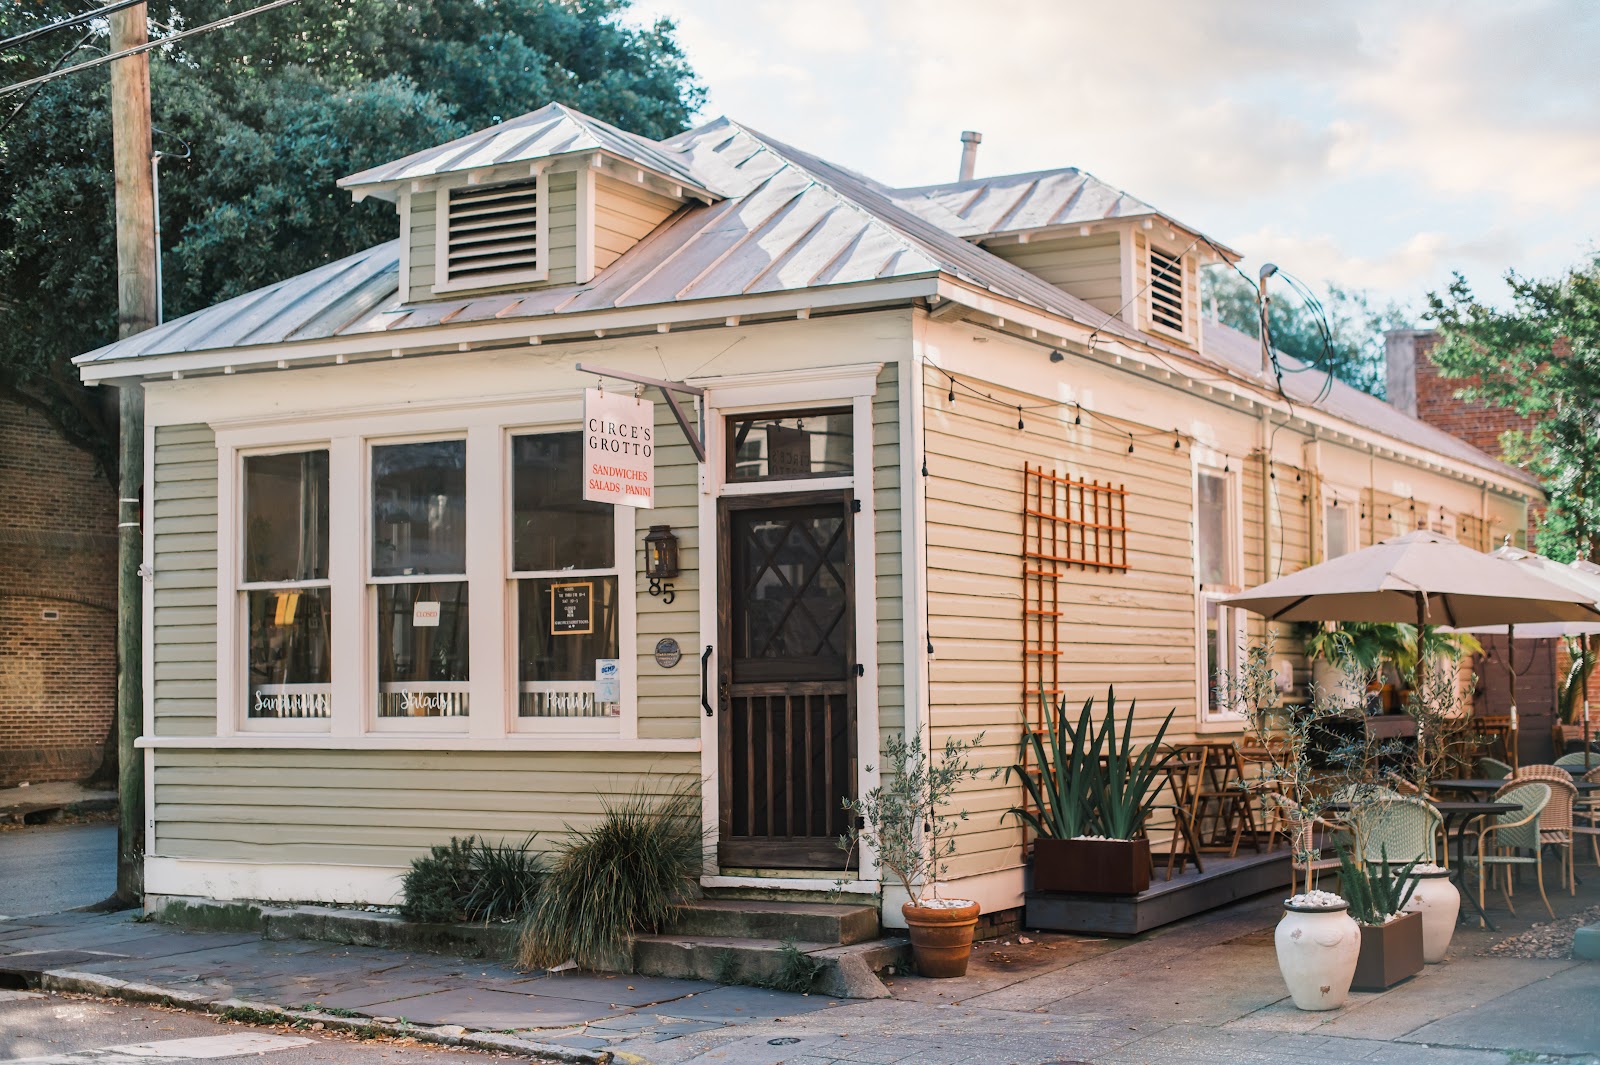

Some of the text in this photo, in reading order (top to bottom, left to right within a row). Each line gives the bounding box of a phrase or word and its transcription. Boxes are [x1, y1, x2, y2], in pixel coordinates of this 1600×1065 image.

[589, 418, 651, 441] CIRCE'S
[589, 436, 652, 458] GROTTO
[592, 463, 648, 482] SANDWICHES
[589, 478, 651, 497] SALADS PANINI
[649, 577, 675, 604] 85
[254, 690, 327, 712] Sandwiches
[400, 689, 449, 710] Salads
[544, 688, 592, 710] Panini
